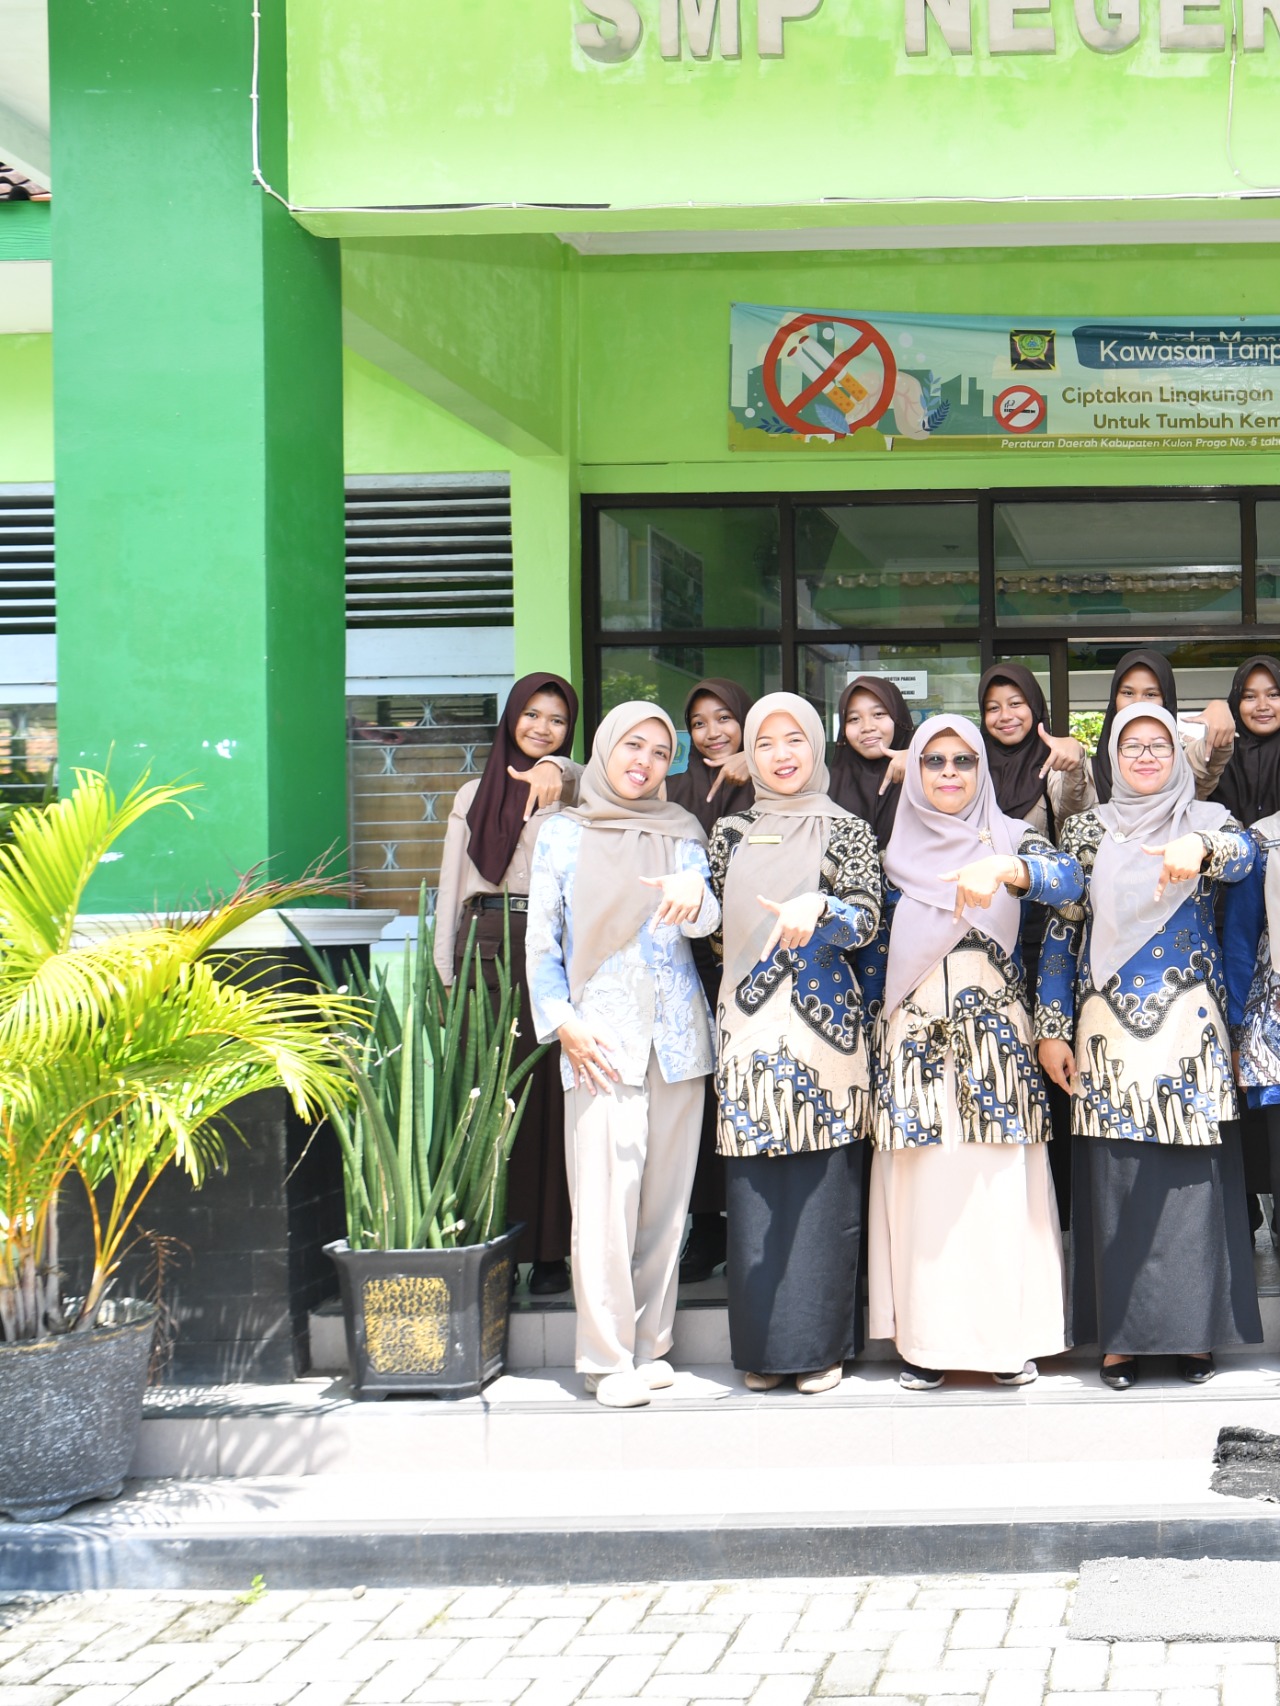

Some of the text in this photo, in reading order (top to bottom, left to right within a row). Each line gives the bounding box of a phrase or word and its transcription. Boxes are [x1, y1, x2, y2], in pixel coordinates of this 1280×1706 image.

[1100, 340, 1216, 362] Kawasan
[1062, 387, 1153, 407] Ciptakan
[1159, 385, 1274, 406] Lingkungan
[1093, 414, 1150, 429] Untuk
[1156, 413, 1234, 429] Tumbuh
[1001, 439, 1055, 449] Peraturan
[1058, 438, 1098, 448] Daerah
[1100, 438, 1160, 449] Kabupaten
[1162, 439, 1193, 448] Kulon
[1195, 438, 1227, 448] Progo
[1230, 437, 1247, 447] No.
